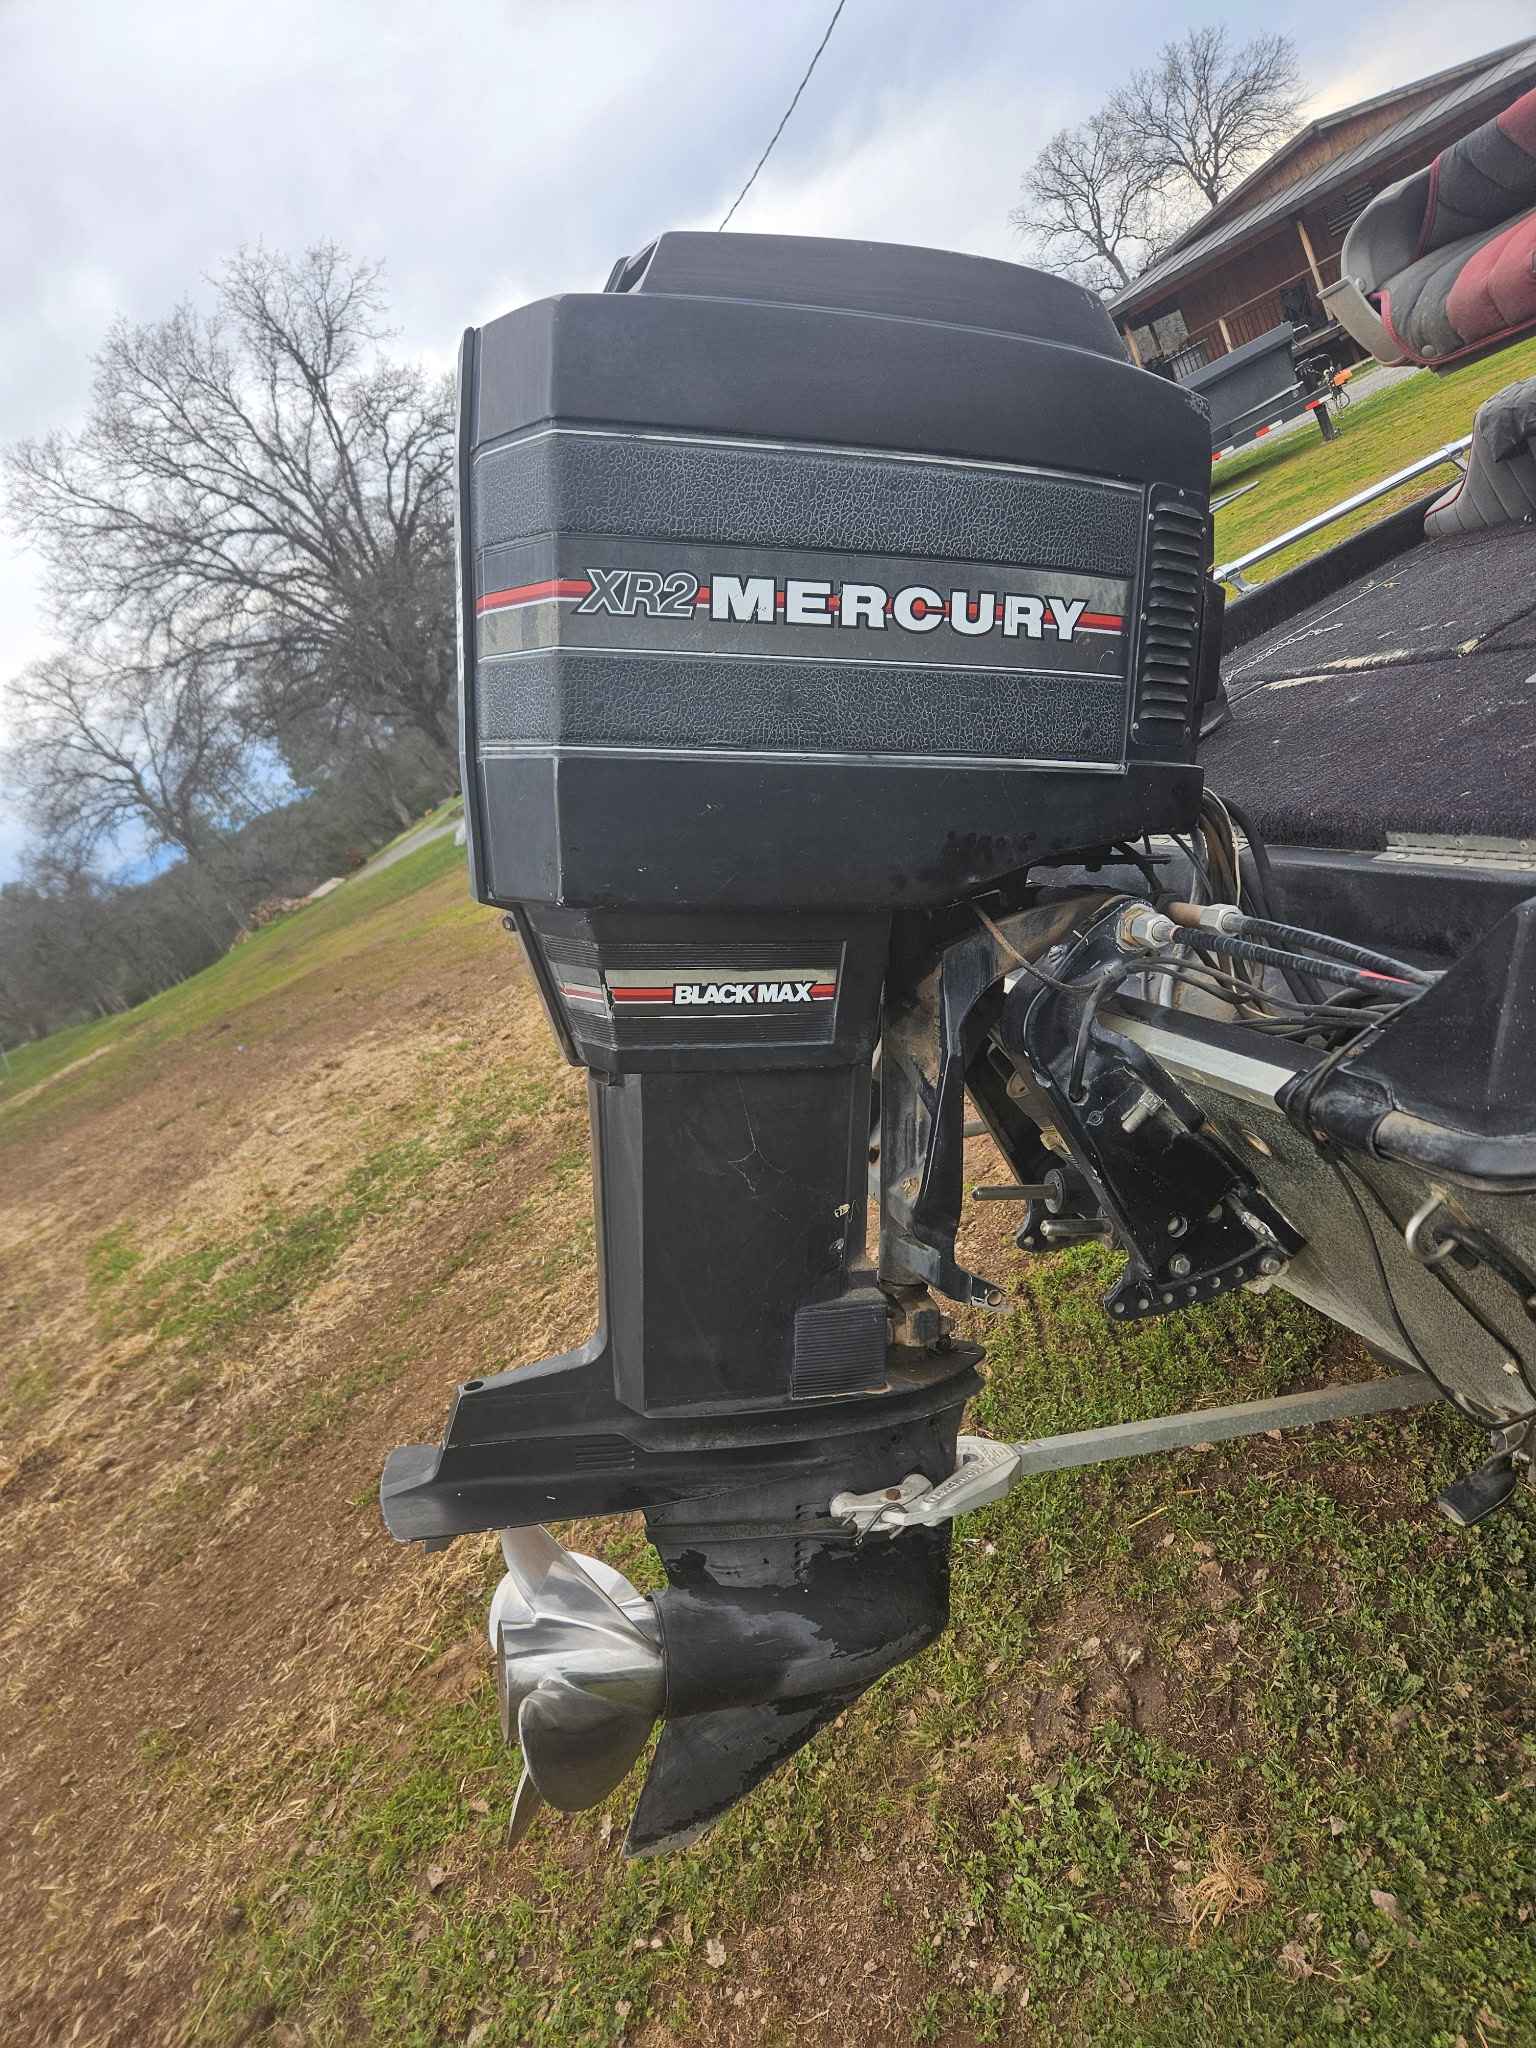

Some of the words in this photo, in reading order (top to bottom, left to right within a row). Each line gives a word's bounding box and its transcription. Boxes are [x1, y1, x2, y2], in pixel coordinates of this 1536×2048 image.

[576, 567, 698, 619] XR2
[709, 574, 1088, 641] MERCURY
[674, 984, 755, 1005] BLACK
[757, 981, 815, 1004] MAX
